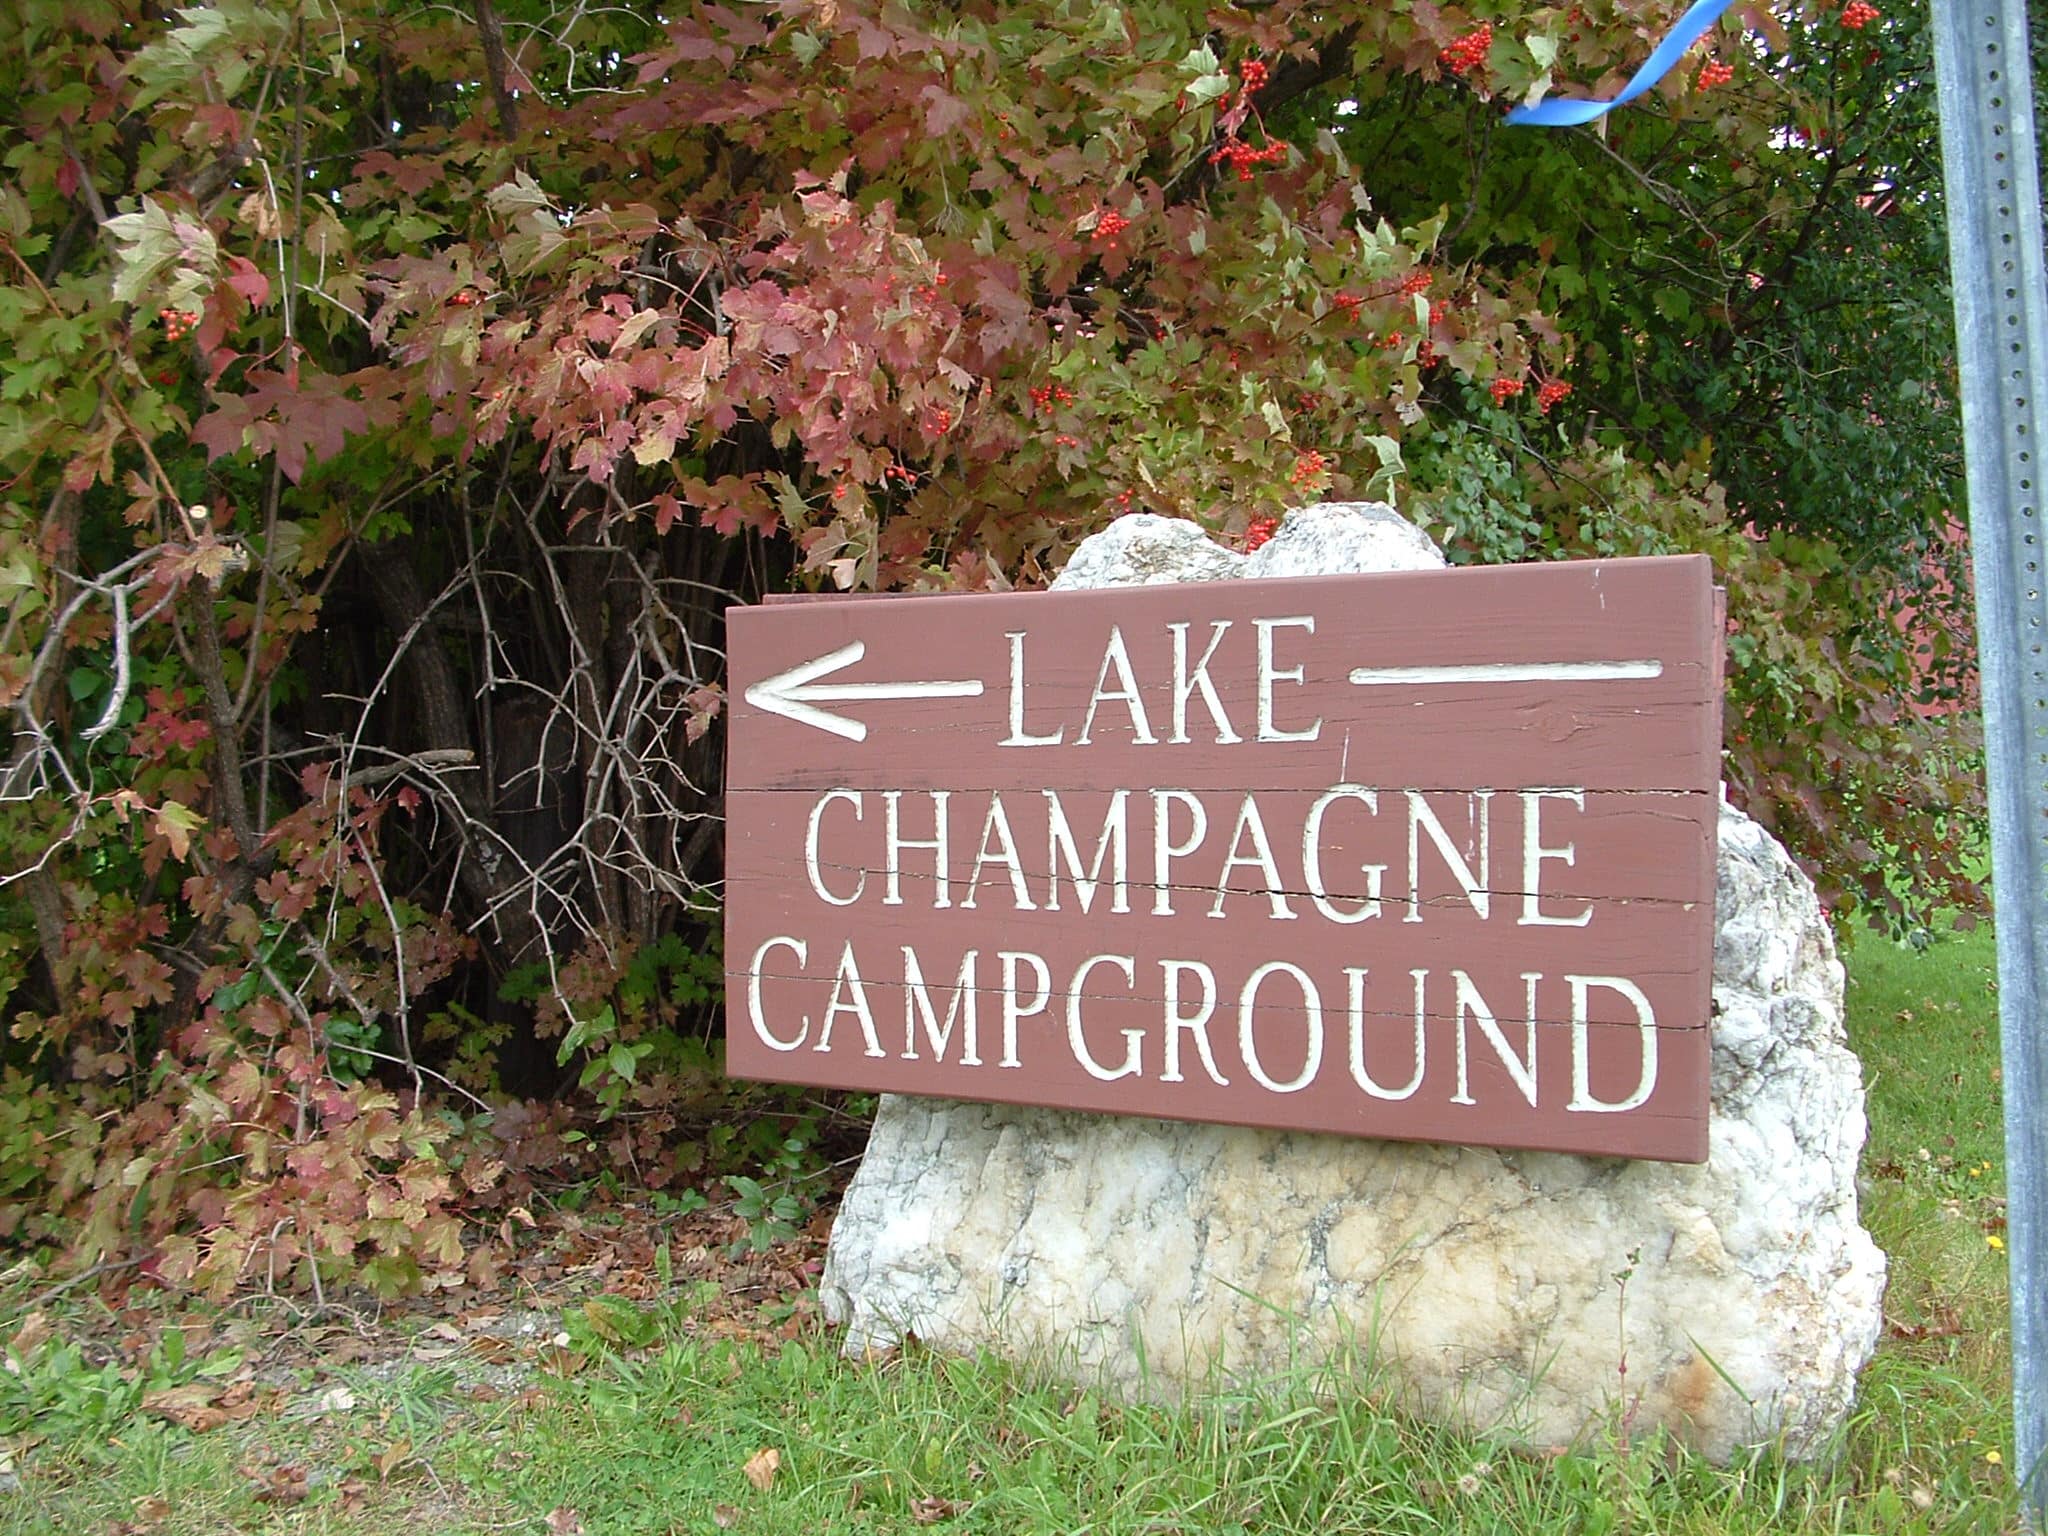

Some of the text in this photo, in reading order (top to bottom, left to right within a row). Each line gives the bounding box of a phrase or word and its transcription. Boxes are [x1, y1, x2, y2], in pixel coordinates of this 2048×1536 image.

[998, 615, 1324, 749] LAKE
[804, 783, 1595, 928] CHAMPAGNE
[746, 935, 1658, 1114] CAMPGROUND
